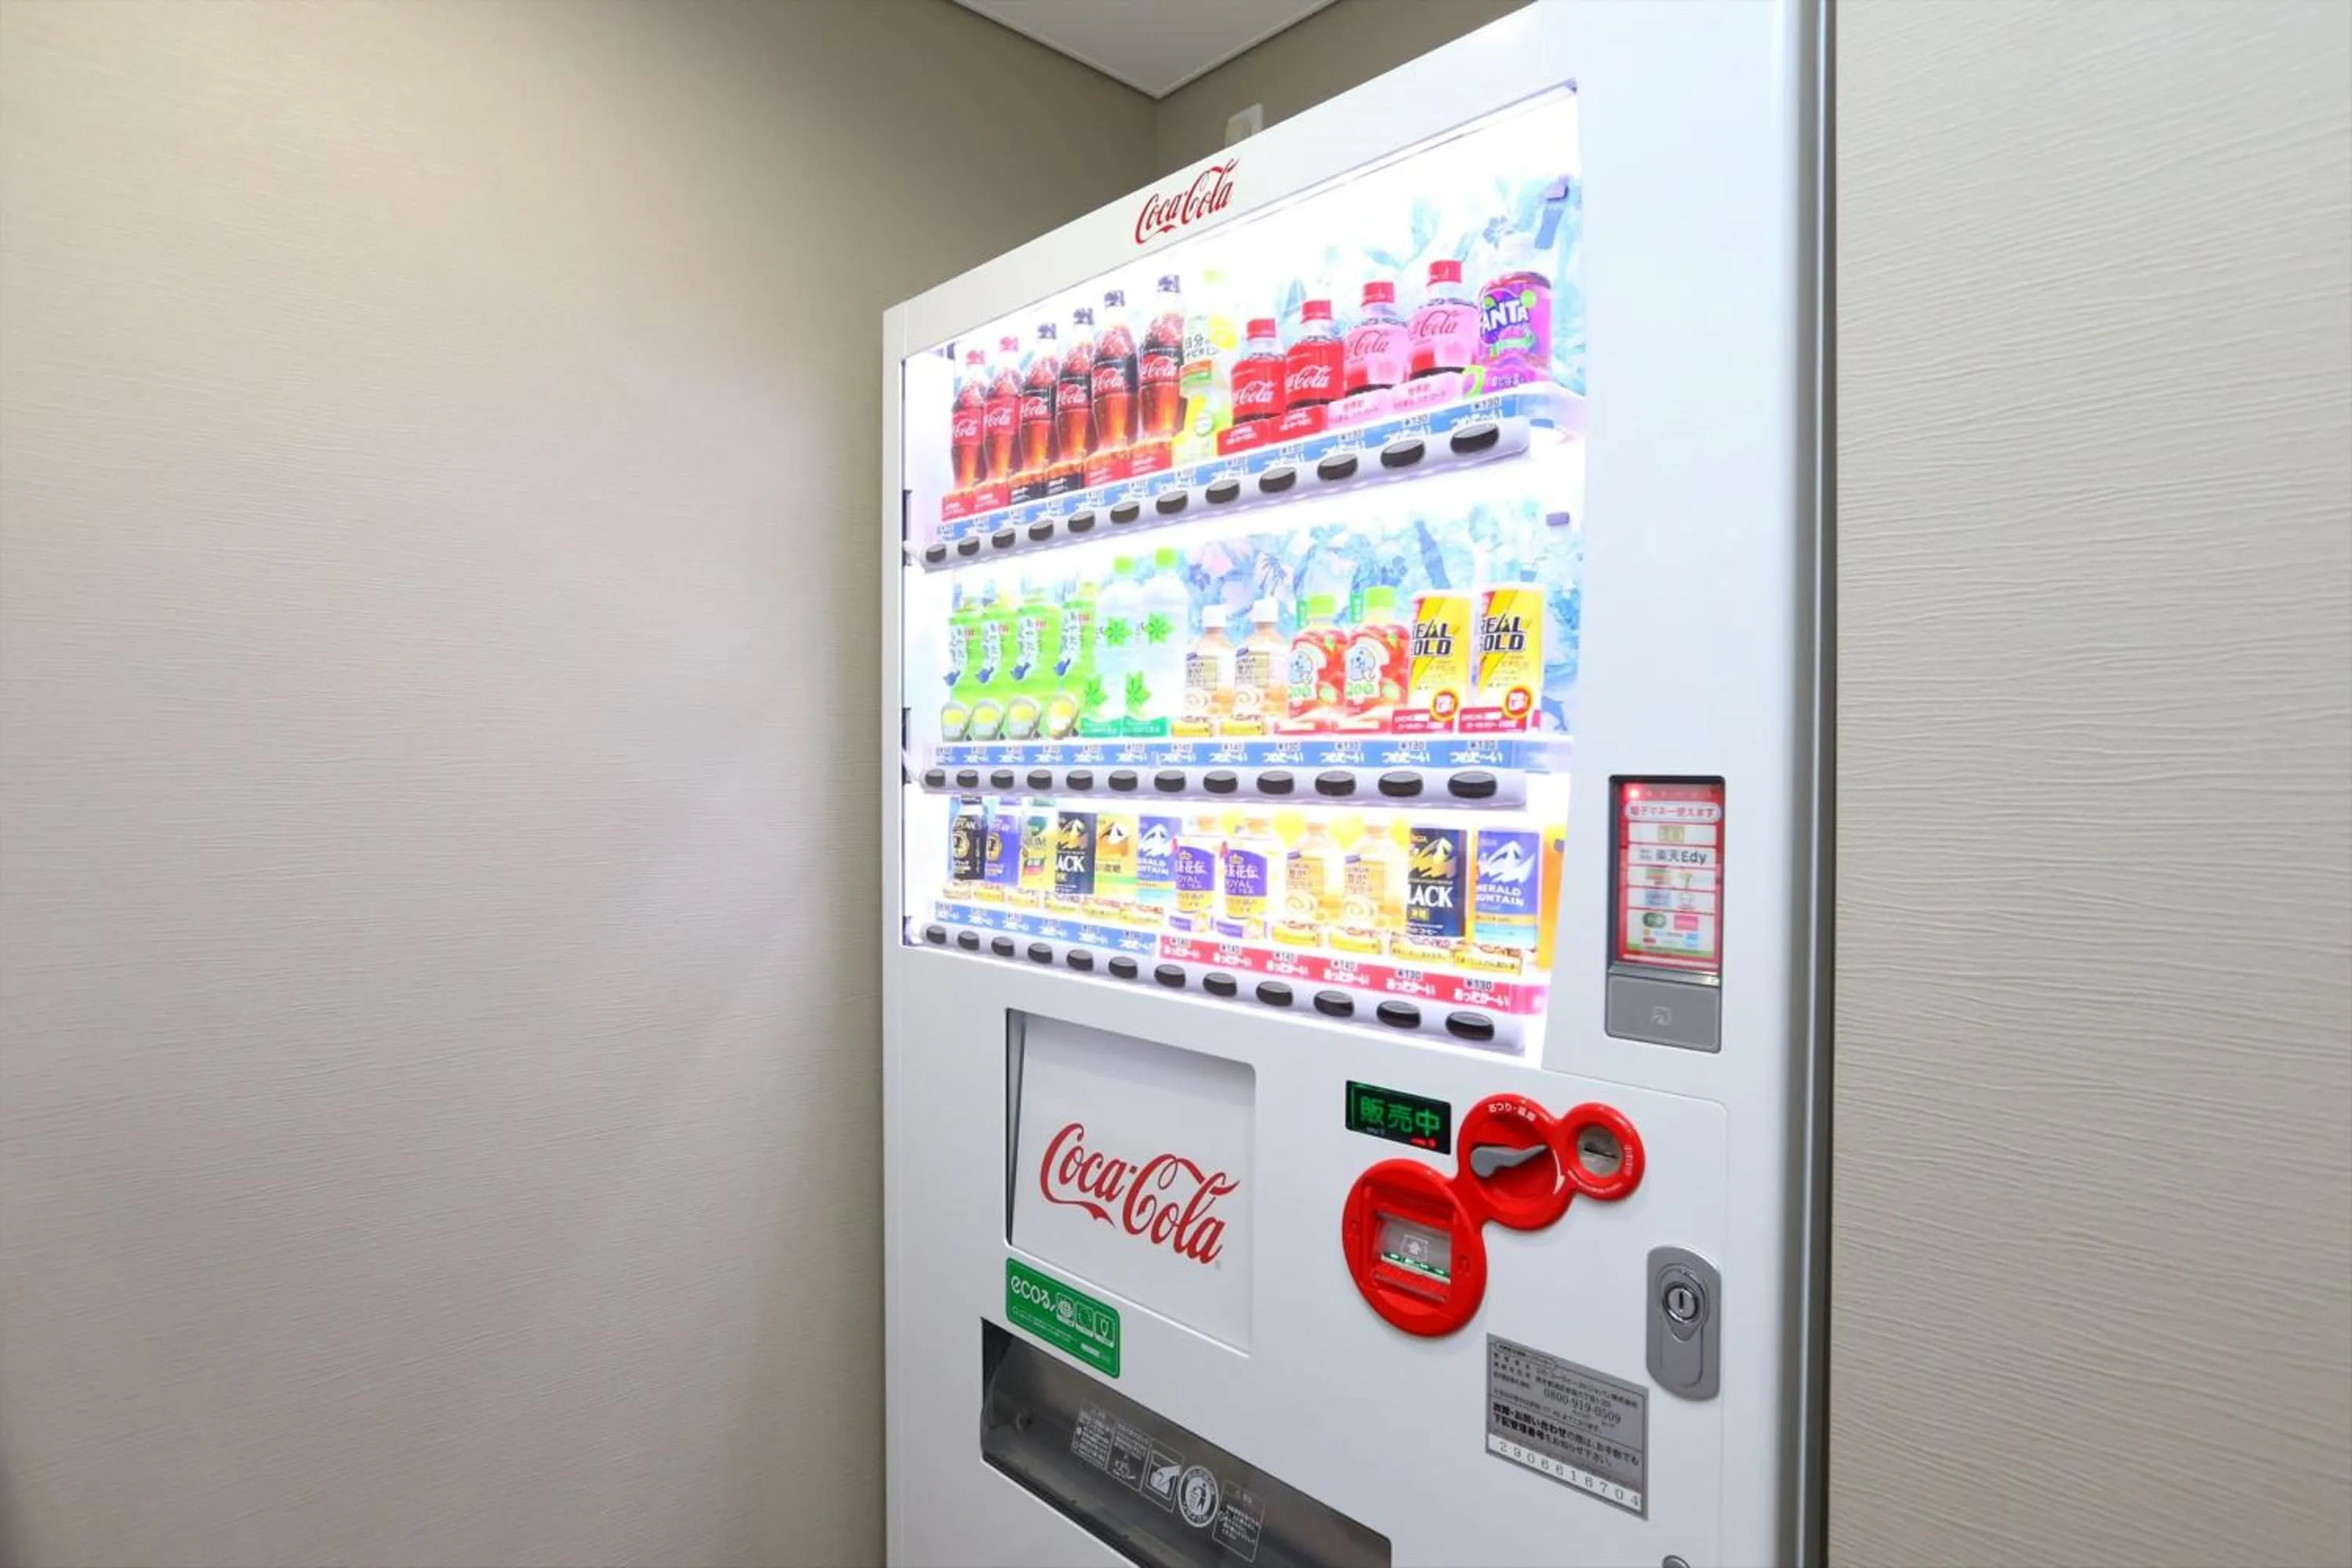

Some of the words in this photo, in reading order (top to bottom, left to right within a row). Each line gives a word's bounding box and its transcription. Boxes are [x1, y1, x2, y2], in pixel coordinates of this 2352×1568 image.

[1134, 158, 1239, 245] Coca-Cola
[1481, 299, 1529, 334] ANTA
[1414, 619, 1454, 639] EAL
[1482, 634, 1525, 652] OLD
[1414, 639, 1452, 657] OLD
[1360, 1095, 1440, 1137] 販売中
[1040, 1123, 1241, 1265] Coca-Cola
